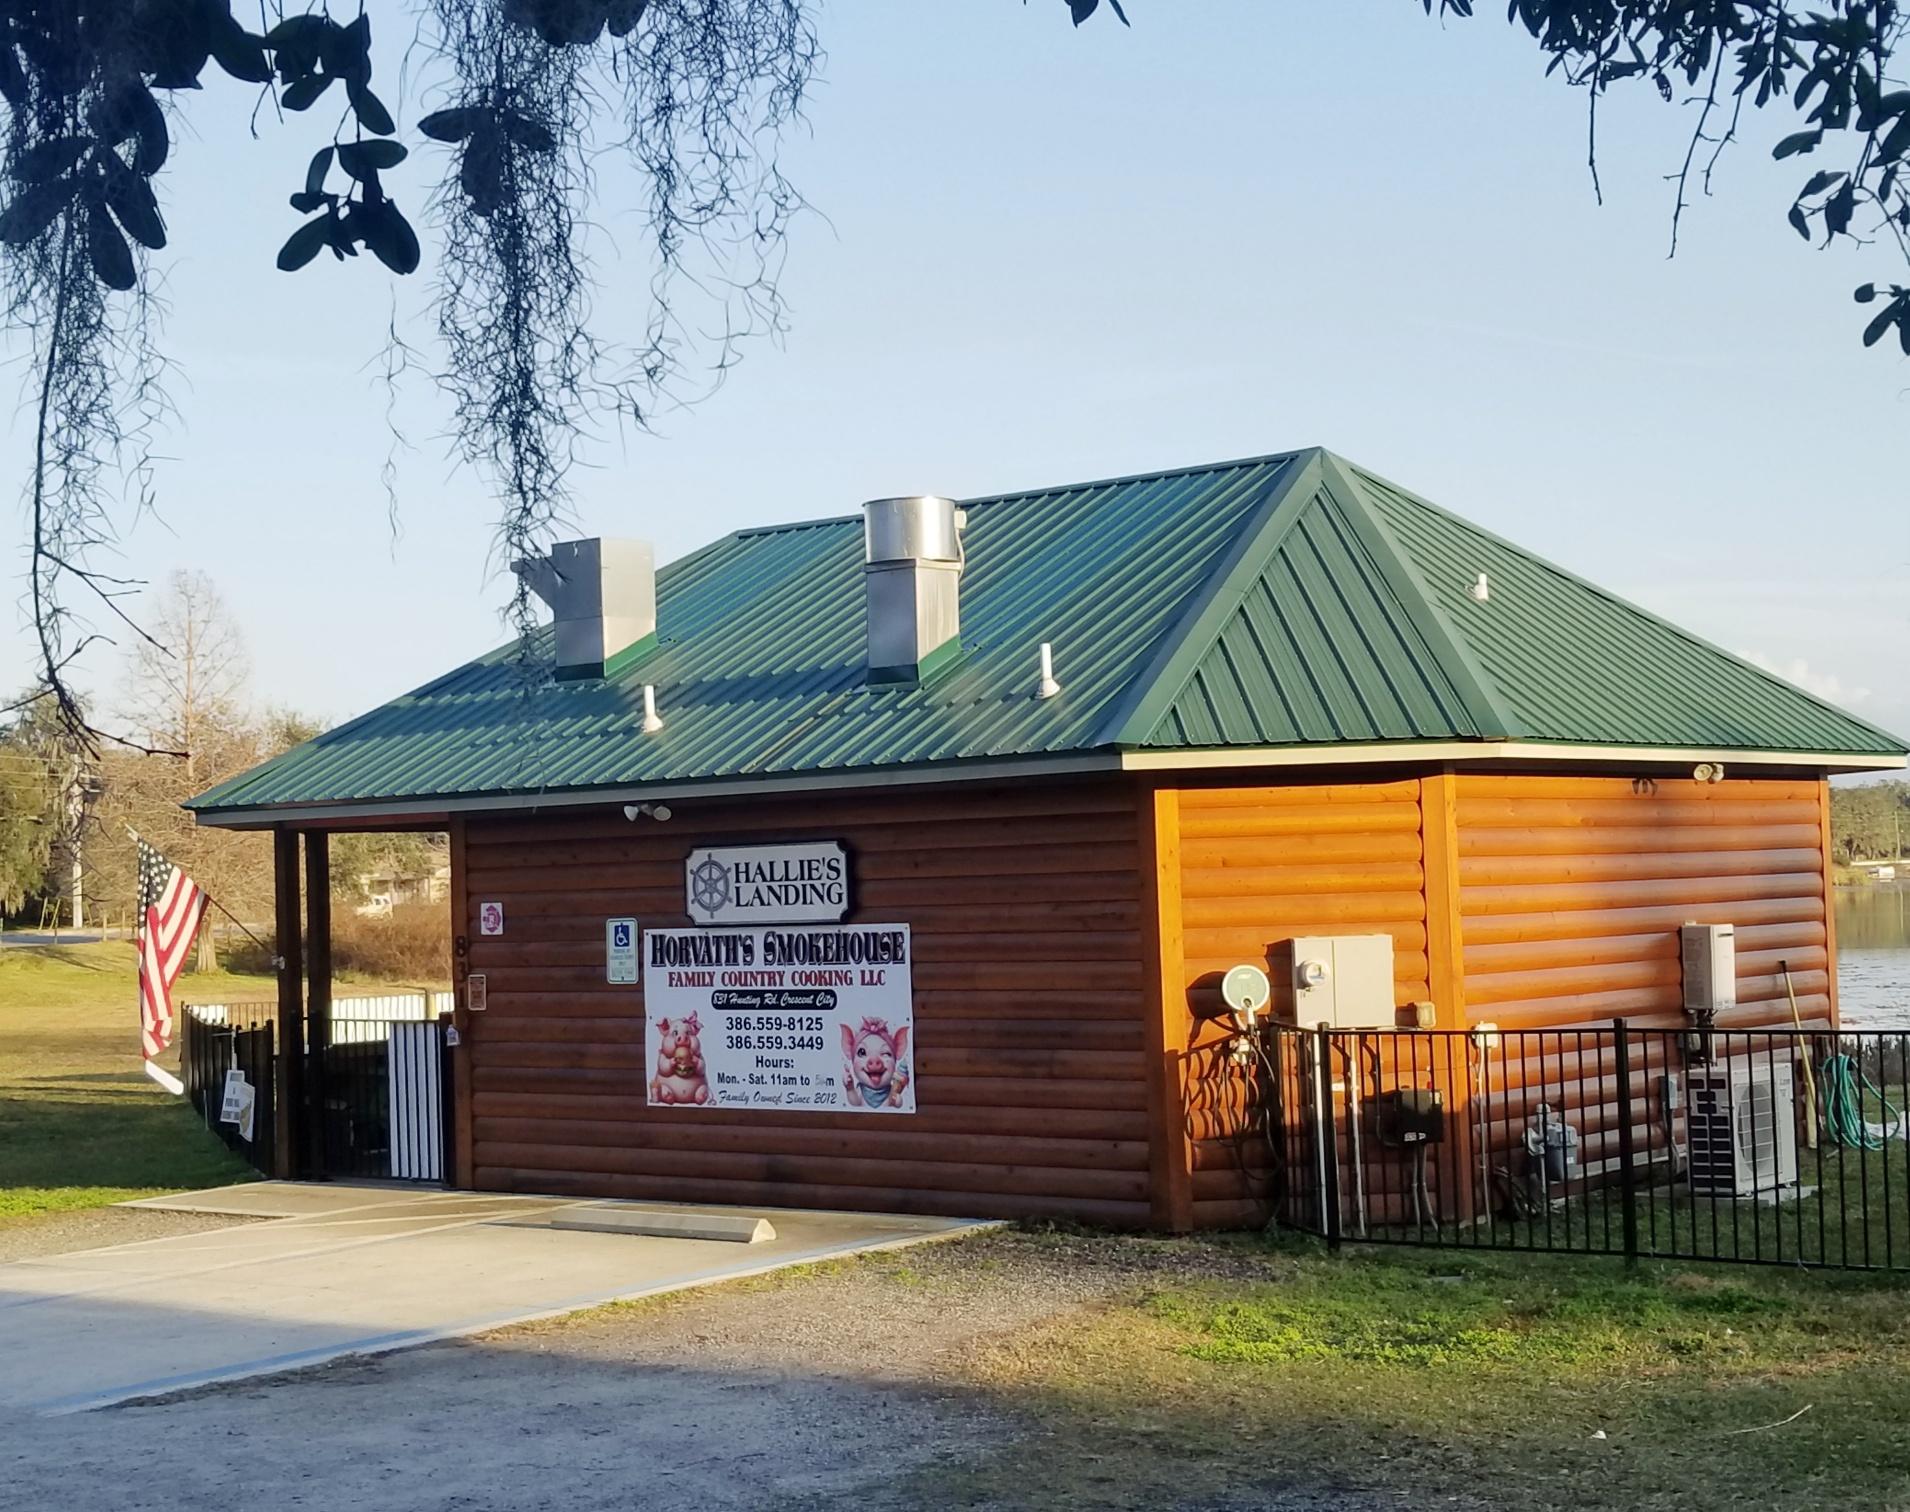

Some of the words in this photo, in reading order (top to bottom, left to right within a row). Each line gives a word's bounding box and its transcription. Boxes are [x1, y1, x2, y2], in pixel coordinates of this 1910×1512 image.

[734, 857, 841, 884] HALLIE'S
[734, 882, 844, 908] LANDING
[651, 932, 755, 968] HORVATH'S
[763, 930, 906, 968] SMOKEHOUSE
[668, 970, 715, 988] FAMILY
[721, 970, 785, 988] COUNTRY
[791, 969, 853, 987] COOKING
[860, 969, 886, 986] LLC
[713, 993, 728, 1005] 831
[763, 993, 779, 1005] Rd.
[780, 991, 814, 1007] Crescent
[816, 991, 835, 1007] City
[726, 1016, 823, 1032] 386.559-8125
[726, 1035, 824, 1050] 386.559.3449
[755, 1055, 794, 1069] Hours:
[717, 1072, 740, 1084] Mon.
[748, 1073, 767, 1085] Sat.
[770, 1073, 797, 1085] 11am
[800, 1074, 810, 1086] to
[718, 1090, 749, 1105] Family
[753, 1091, 782, 1105] Owned
[785, 1092, 810, 1104] Since
[813, 1092, 837, 1104] 2012
